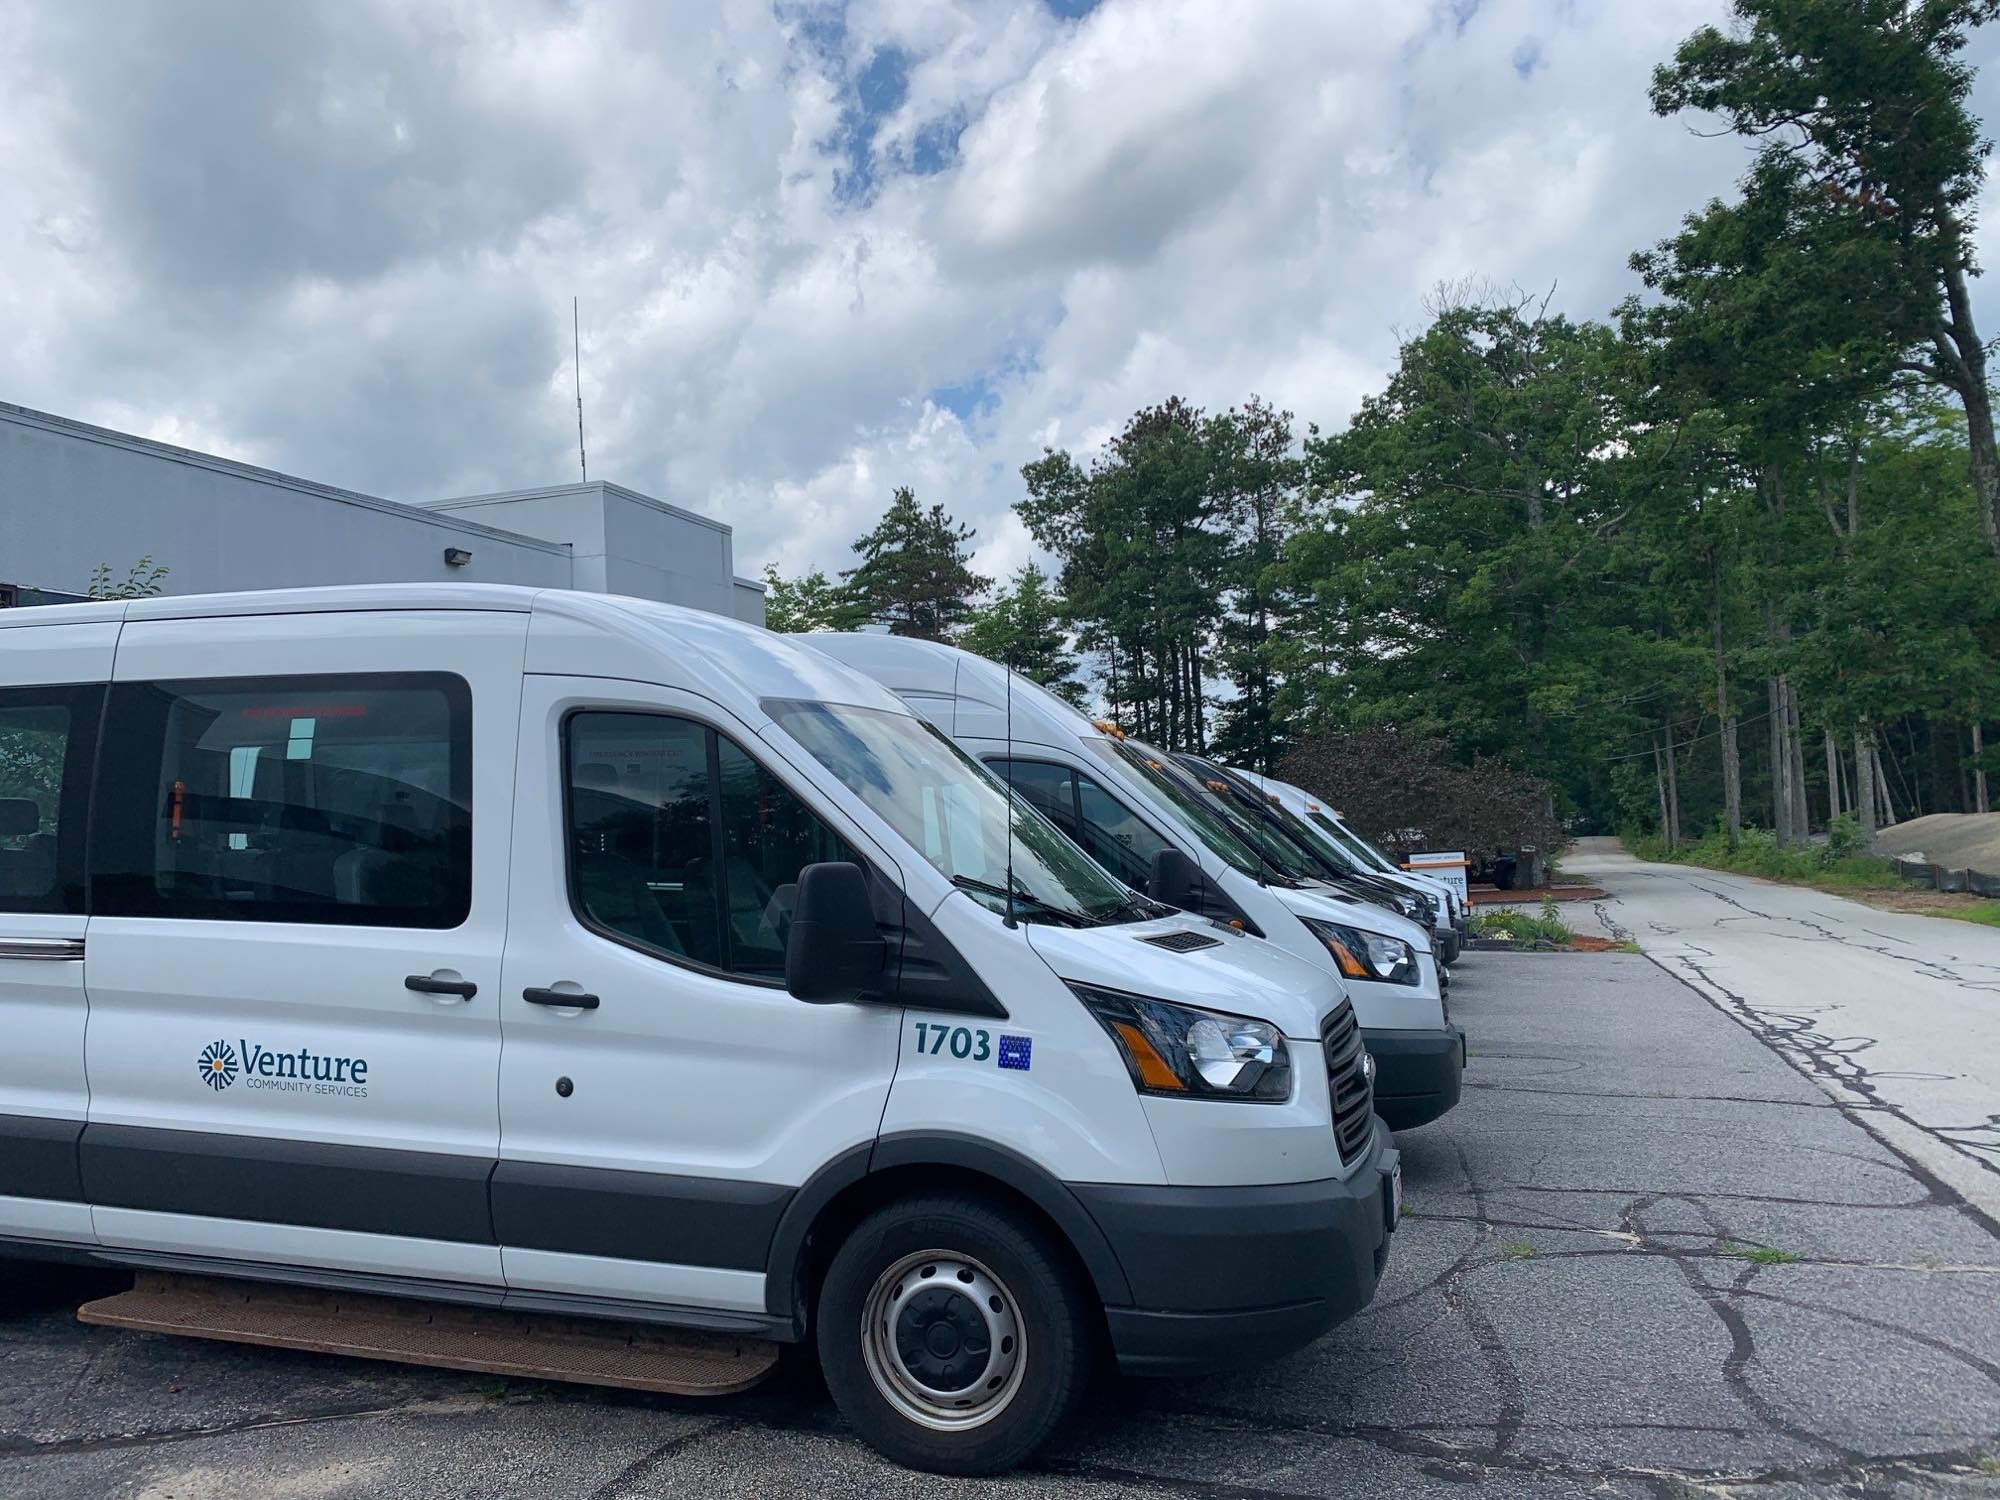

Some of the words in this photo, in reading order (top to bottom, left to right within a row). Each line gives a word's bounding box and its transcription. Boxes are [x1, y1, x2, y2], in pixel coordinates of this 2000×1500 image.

[915, 1022, 991, 1061] 1703
[240, 1039, 368, 1084] Venture
[246, 1077, 312, 1093] COMMUNITY
[314, 1083, 368, 1098] SERVICES
